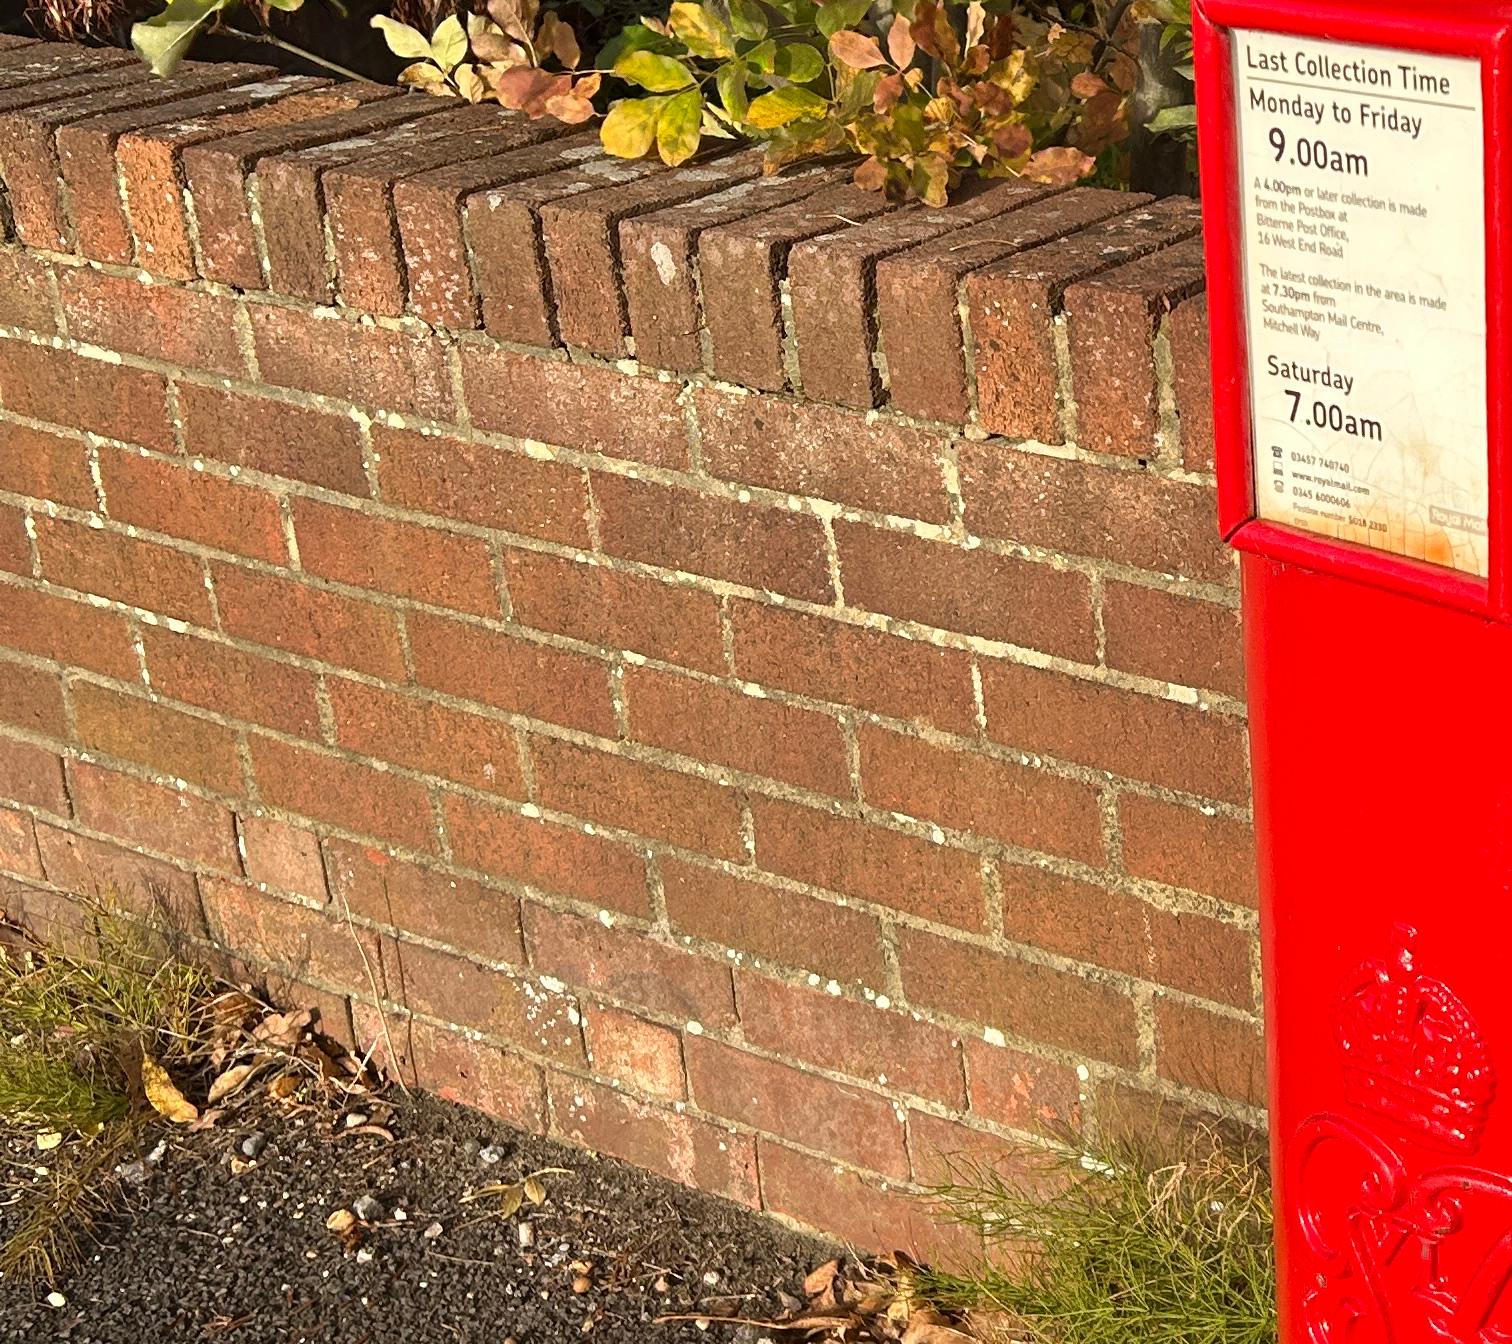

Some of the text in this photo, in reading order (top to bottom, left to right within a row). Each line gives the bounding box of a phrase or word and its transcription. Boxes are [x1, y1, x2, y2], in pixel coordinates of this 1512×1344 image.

[1247, 45, 1450, 95] Last Collection Time
[1250, 88, 1422, 139] Monday to Friday
[1269, 128, 1368, 176] 9.00am
[1255, 195, 1348, 223] from the Postbox at
[1264, 178, 1301, 197] 4.00pm
[1304, 188, 1314, 198] or
[1317, 186, 1338, 202] later
[1341, 192, 1386, 210] collection
[1388, 198, 1396, 213] is
[1400, 203, 1427, 217] made
[1258, 231, 1343, 258] 16 West End Road
[1297, 219, 1318, 236] Post
[1260, 263, 1446, 311] The latest collection in the area is made
[1261, 283, 1336, 307] at 7.30pm from
[1262, 299, 1325, 323] Southampton
[1327, 312, 1347, 328] Mail
[1263, 317, 1321, 342] Mitchell Way
[1267, 355, 1354, 395] Saturday
[1284, 389, 1382, 441] 7.00am
